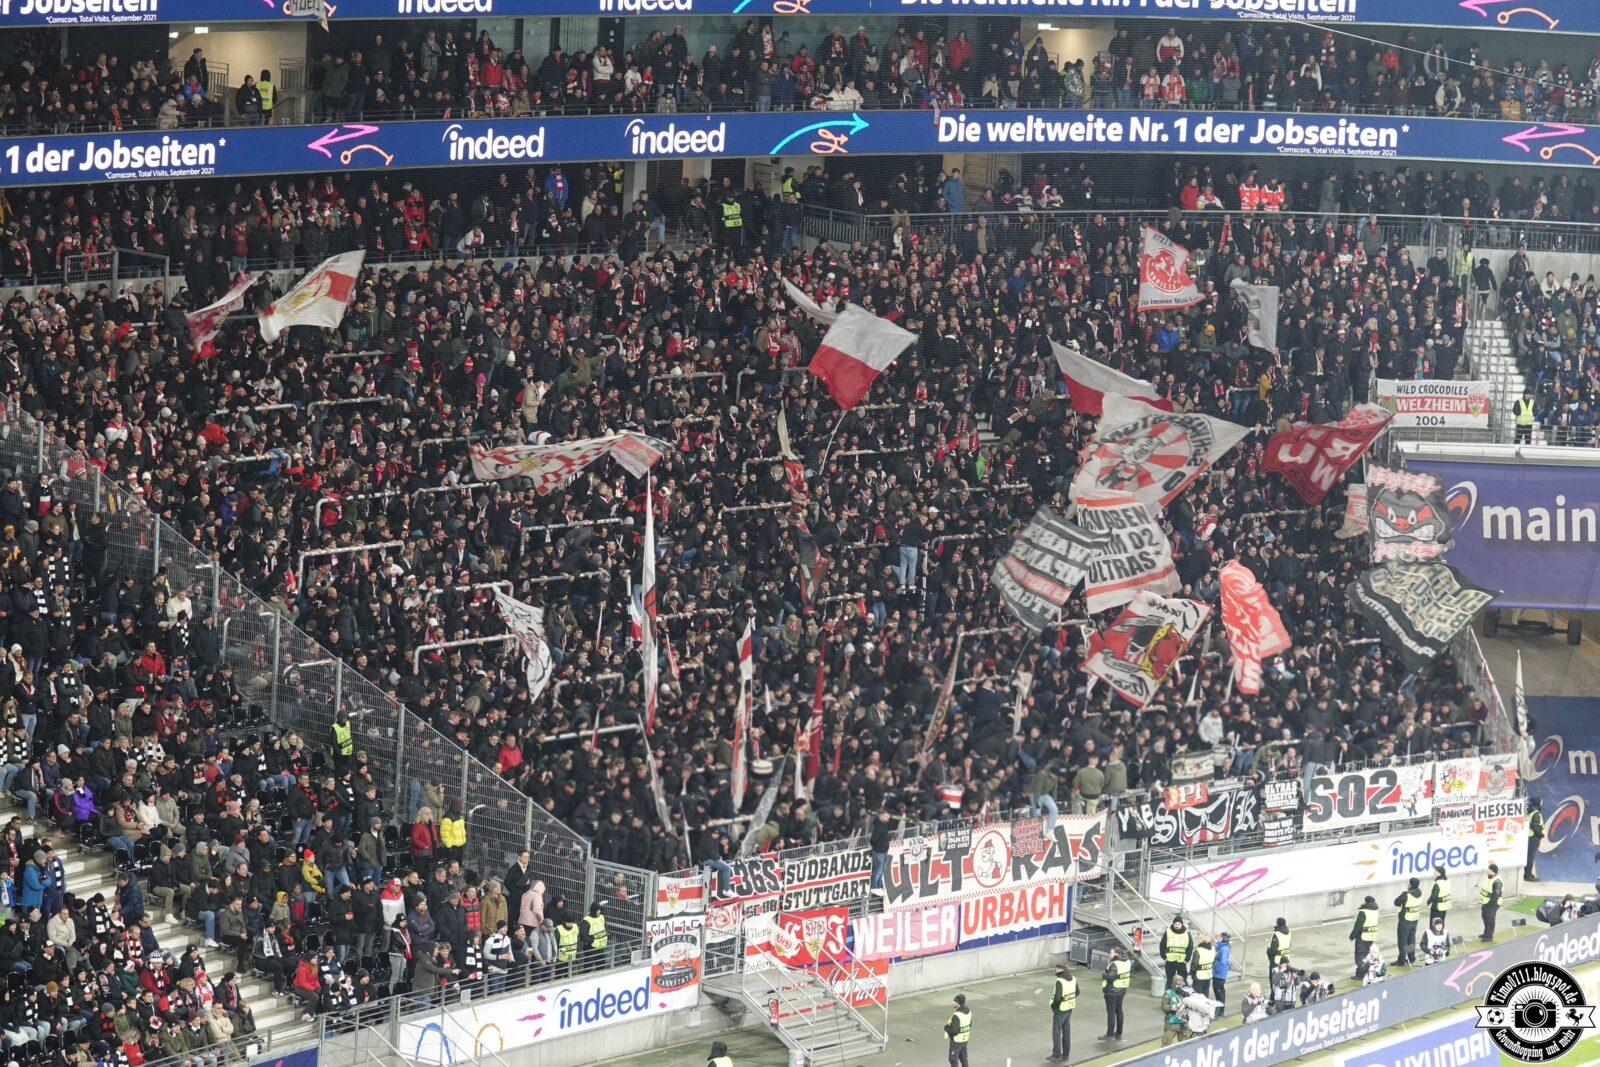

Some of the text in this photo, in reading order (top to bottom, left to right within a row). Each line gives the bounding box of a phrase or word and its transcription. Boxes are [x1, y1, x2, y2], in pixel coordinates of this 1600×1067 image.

[79, 14, 93, 22] Total
[111, 14, 142, 22] September
[1307, 14, 1339, 22] September
[449, 126, 545, 161] indeed
[632, 122, 726, 154] indeed
[938, 114, 981, 142] Die
[987, 114, 1122, 142] weltweite
[1129, 117, 1169, 142] Nr.
[1174, 117, 1187, 142] 1
[1194, 117, 1244, 143] der
[6, 146, 20, 174] 1
[26, 142, 74, 172] der
[1347, 149, 1380, 157] September
[169, 168, 200, 177] September
[1396, 385, 1468, 396] WILD CROCODILES
[1396, 397, 1466, 413] WELZHEIM
[1416, 416, 1446, 426] 2004
[1482, 494, 1597, 543] main
[1088, 551, 1157, 584] ULTRAS
[1477, 801, 1523, 819] HESSEN
[786, 850, 872, 885] SÜDBANDE
[1392, 841, 1478, 876] indeed
[783, 878, 871, 911] STUTTGART
[963, 883, 1064, 936] URBACH
[853, 904, 956, 957] WEILER
[560, 976, 650, 1030] indeed
[1197, 1046, 1225, 1067] Nr.
[1229, 1041, 1244, 1064] 1
[1245, 1028, 1279, 1061] der
